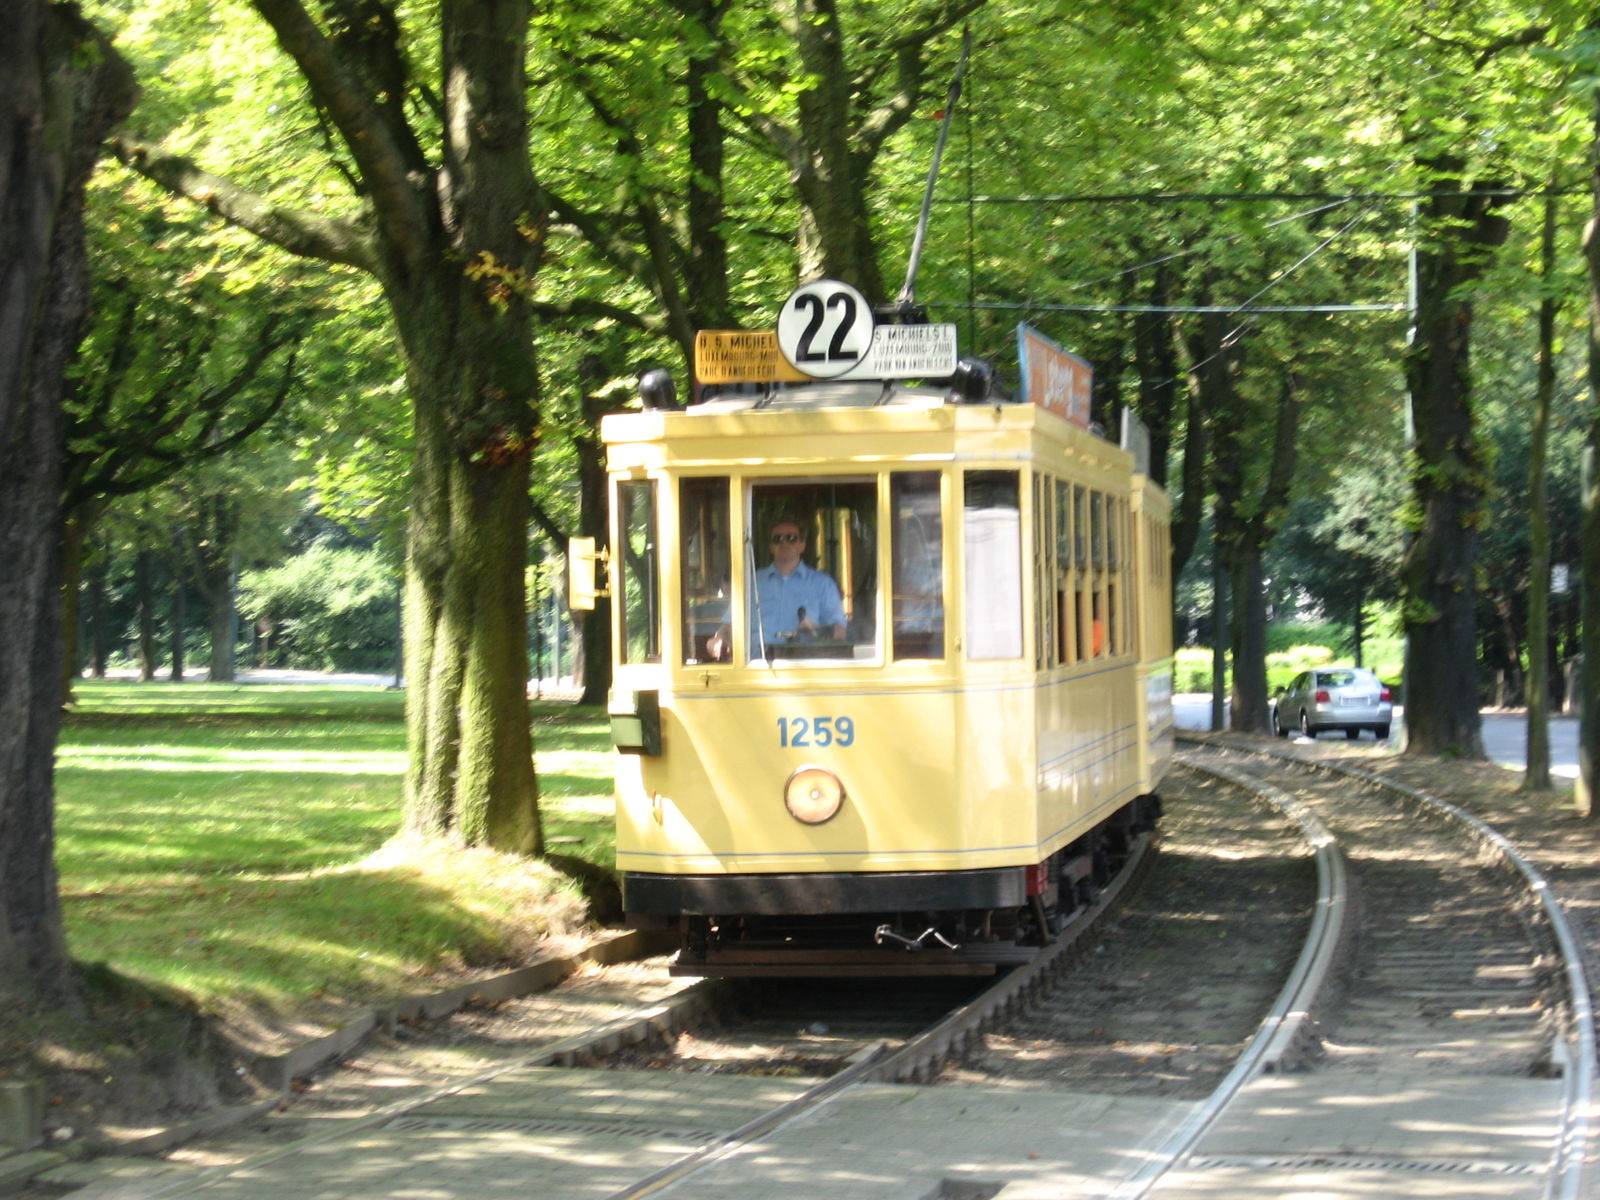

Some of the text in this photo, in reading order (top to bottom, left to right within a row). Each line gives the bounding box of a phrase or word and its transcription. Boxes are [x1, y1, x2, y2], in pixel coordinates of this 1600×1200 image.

[730, 335, 773, 349] MICHEL
[795, 292, 858, 361] 22
[777, 716, 855, 748] 1259
